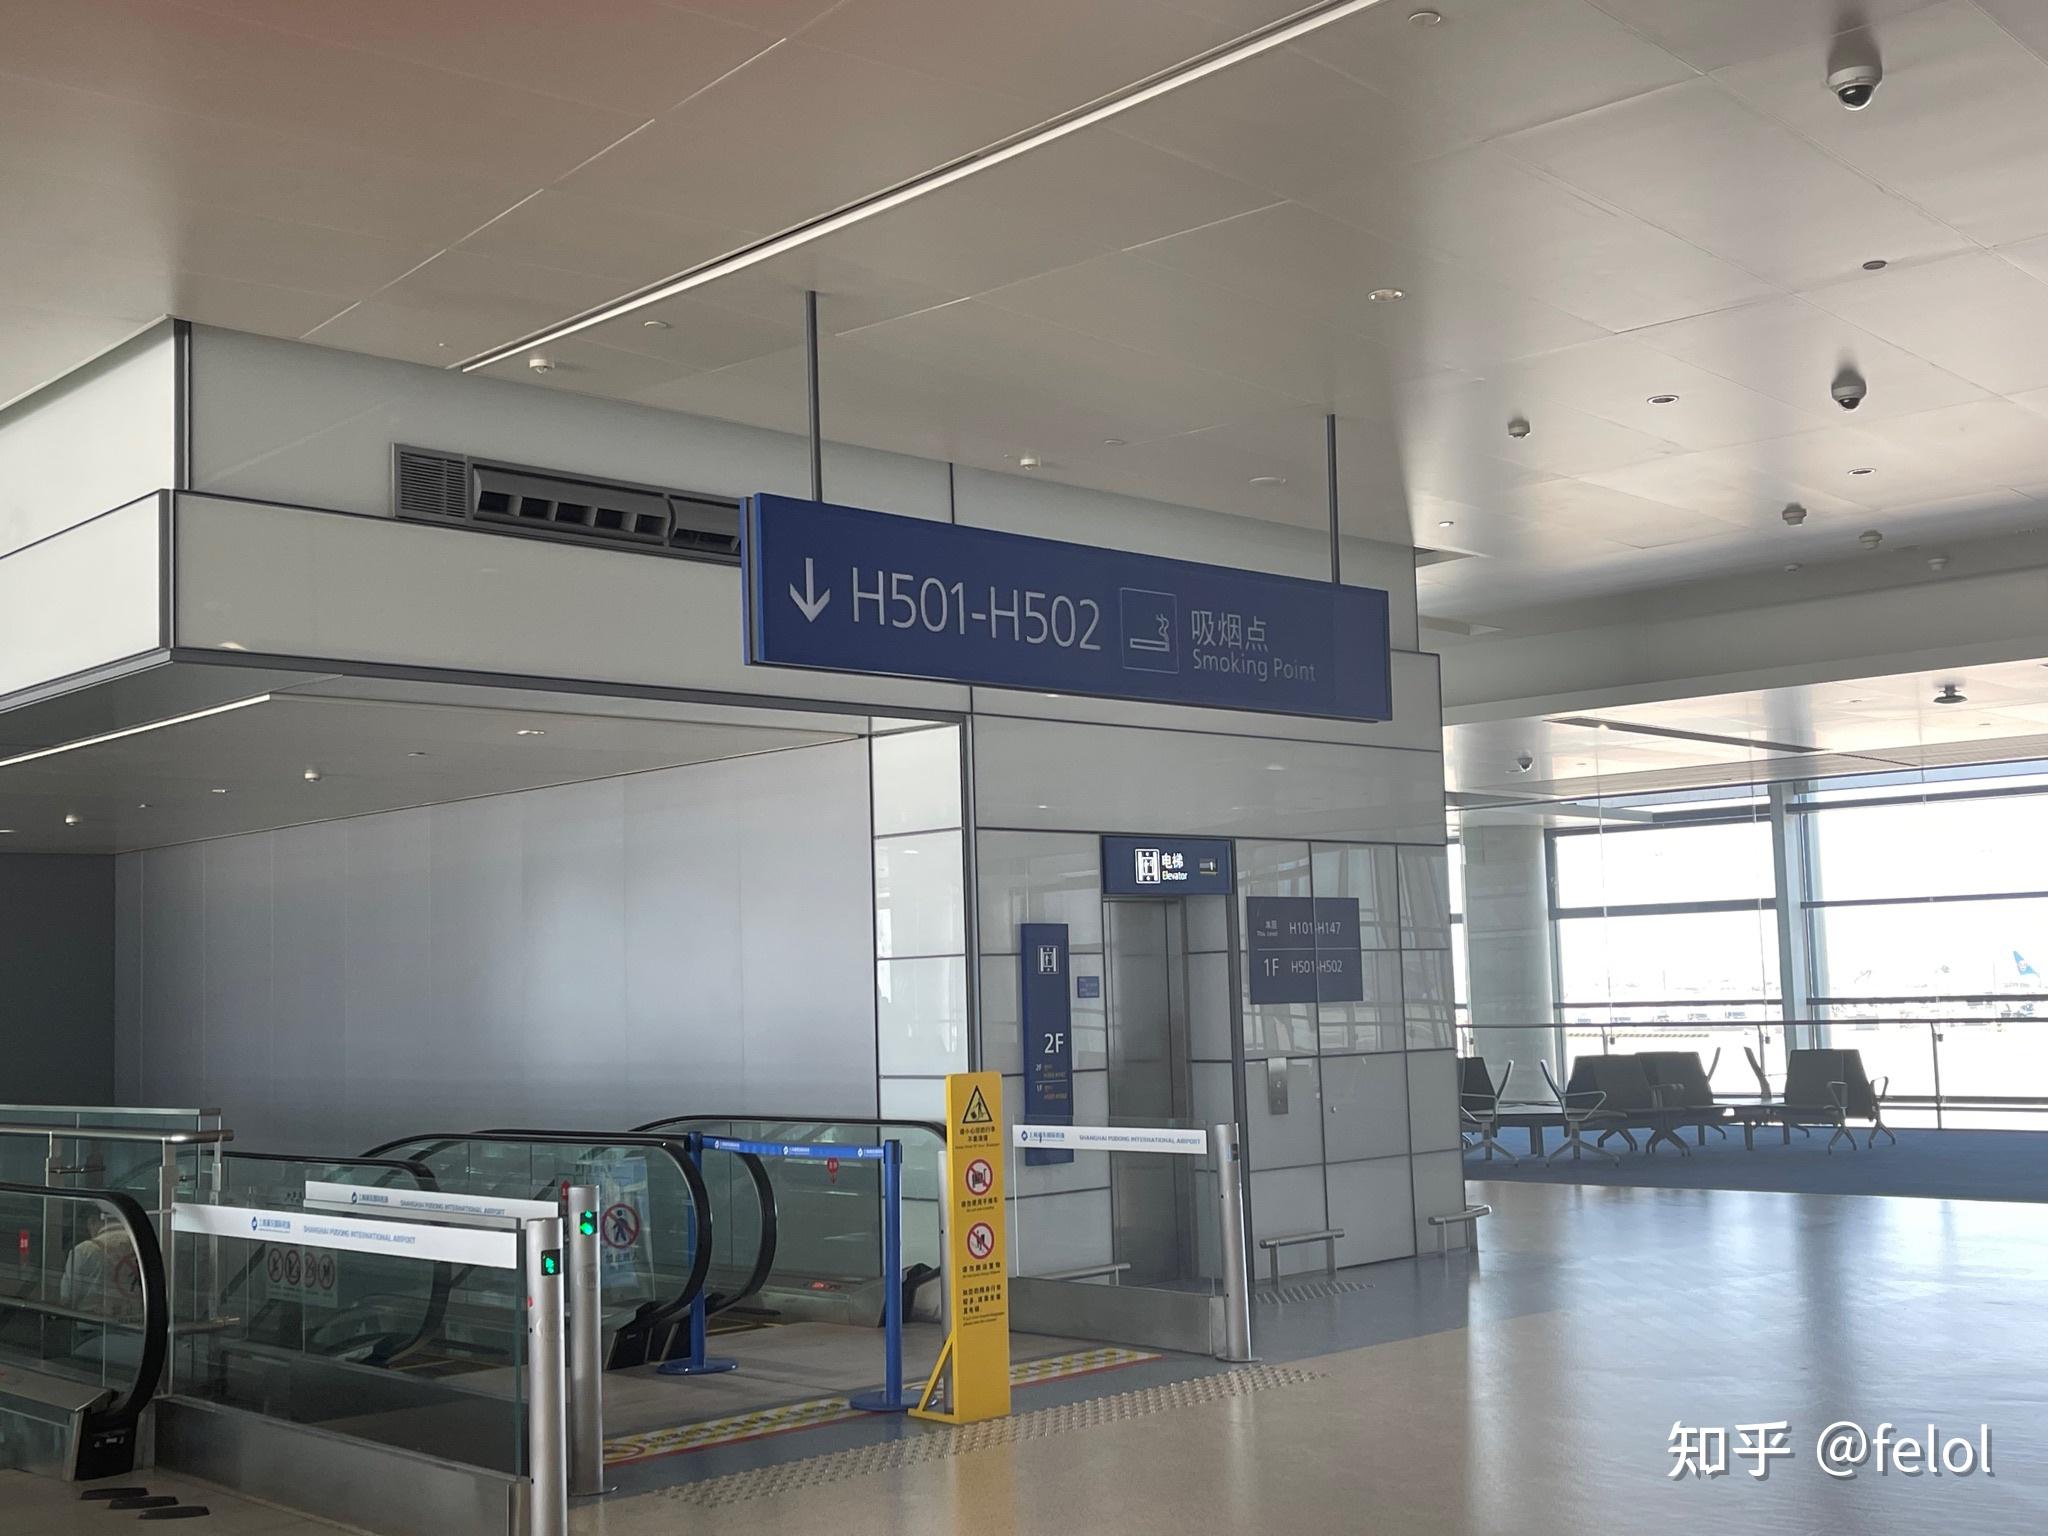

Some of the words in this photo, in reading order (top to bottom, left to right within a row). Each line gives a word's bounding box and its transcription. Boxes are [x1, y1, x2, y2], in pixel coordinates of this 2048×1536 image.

[851, 566, 1102, 651] H501-H502
[1191, 609, 1270, 653] 吸烟点
[1193, 650, 1268, 682] Smoking
[1273, 658, 1317, 682] Point
[1161, 852, 1184, 869] 电梯
[1161, 870, 1188, 881] Elevator
[1263, 958, 1280, 977] 1F
[1291, 960, 1343, 974] H501-H502
[1044, 1033, 1064, 1054] 2F
